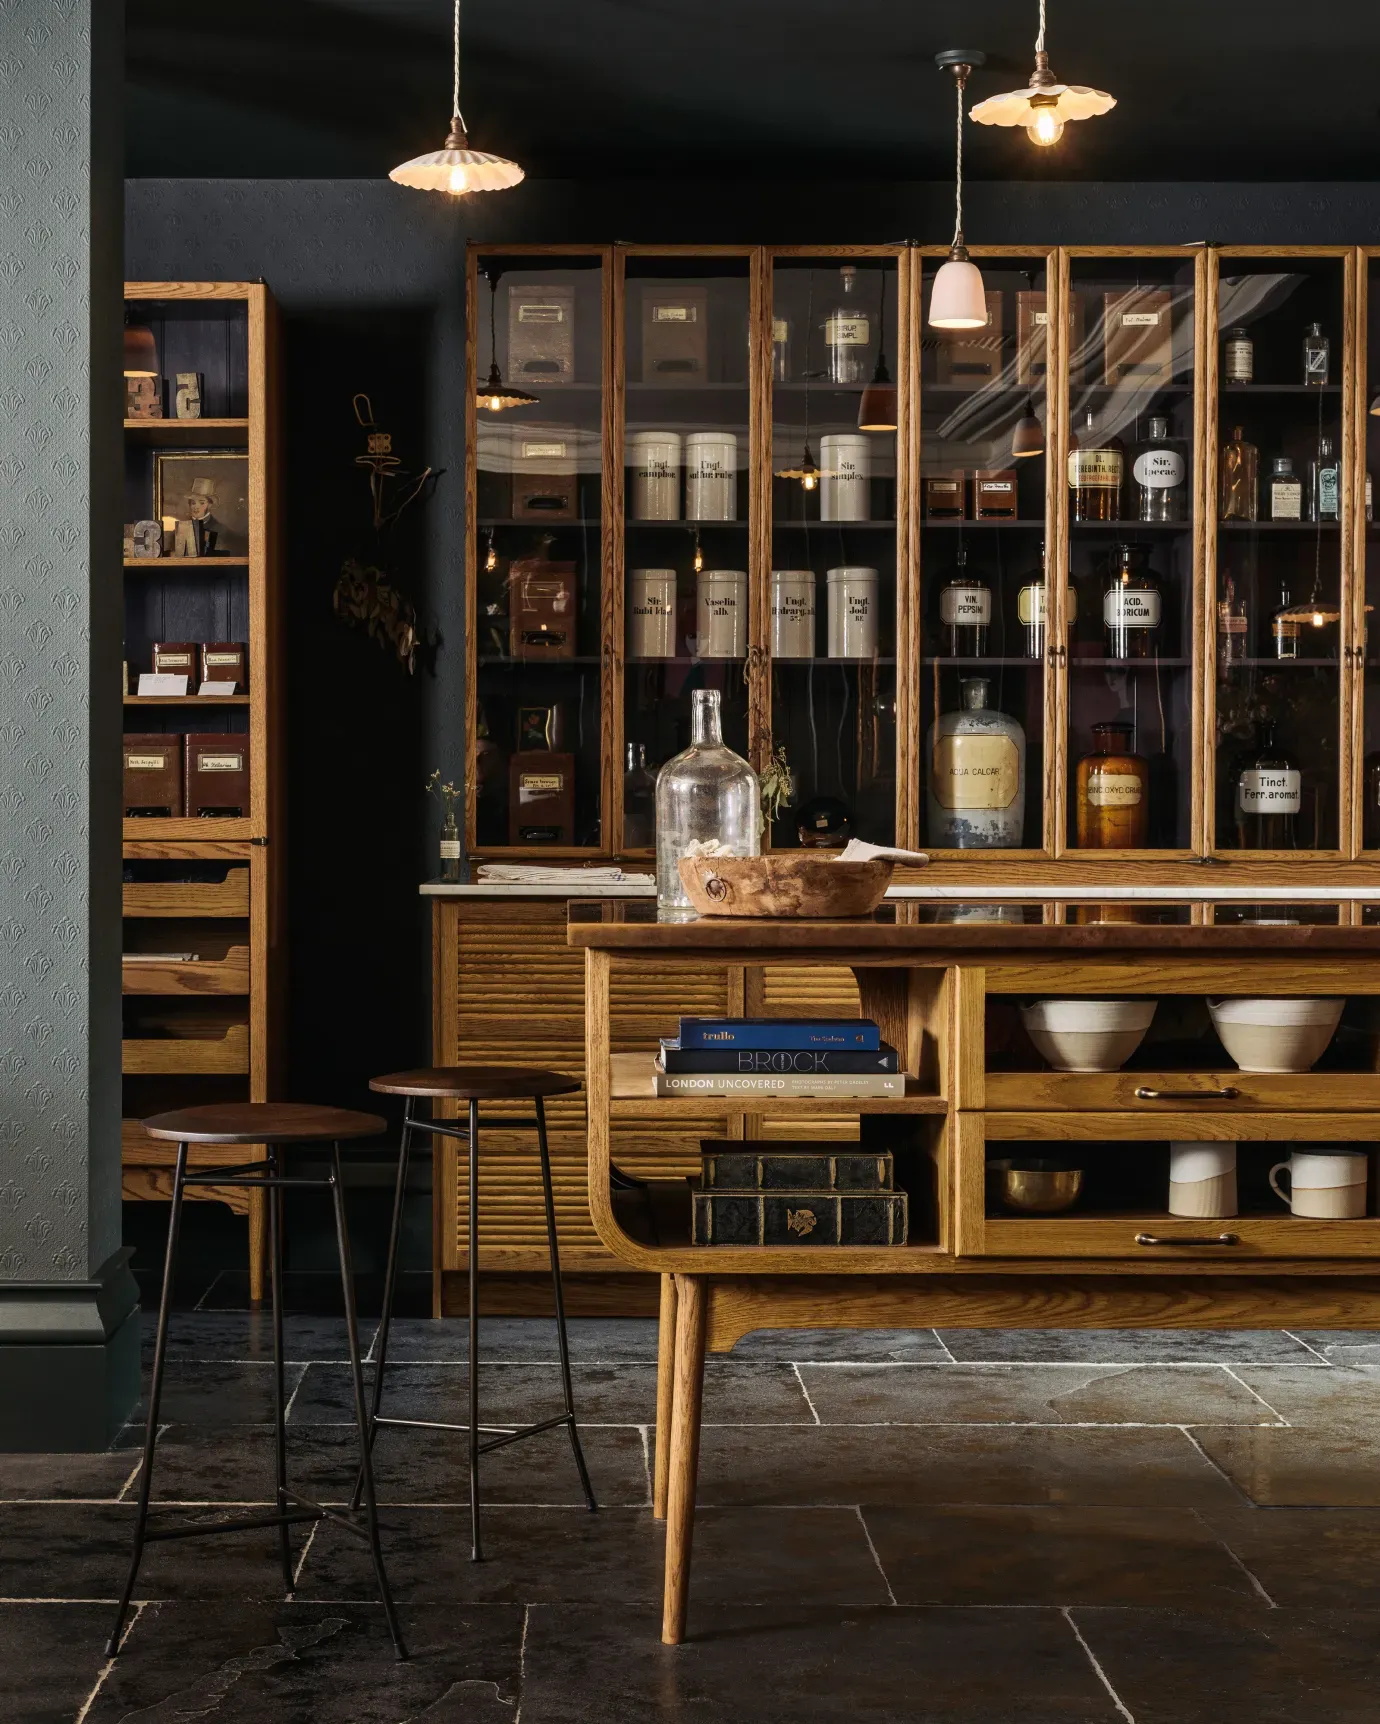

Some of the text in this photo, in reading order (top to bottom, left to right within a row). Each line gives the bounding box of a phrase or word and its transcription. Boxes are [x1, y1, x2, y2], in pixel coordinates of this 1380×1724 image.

[841, 462, 856, 470] Sir.
[1152, 457, 1171, 466] Sir.
[831, 472, 864, 481] simplex
[785, 597, 807, 607] Ungt.
[849, 596, 870, 607] Ungt.
[964, 595, 978, 604] VIN.
[1124, 597, 1143, 606] ACID.
[713, 607, 729, 615] alb.
[849, 606, 868, 615] Jodi
[1259, 777, 1288, 787] Tinct.
[702, 1031, 735, 1040] trullo
[738, 1051, 830, 1072] BROCK
[666, 1079, 785, 1088] LONDON UNCOVERED
